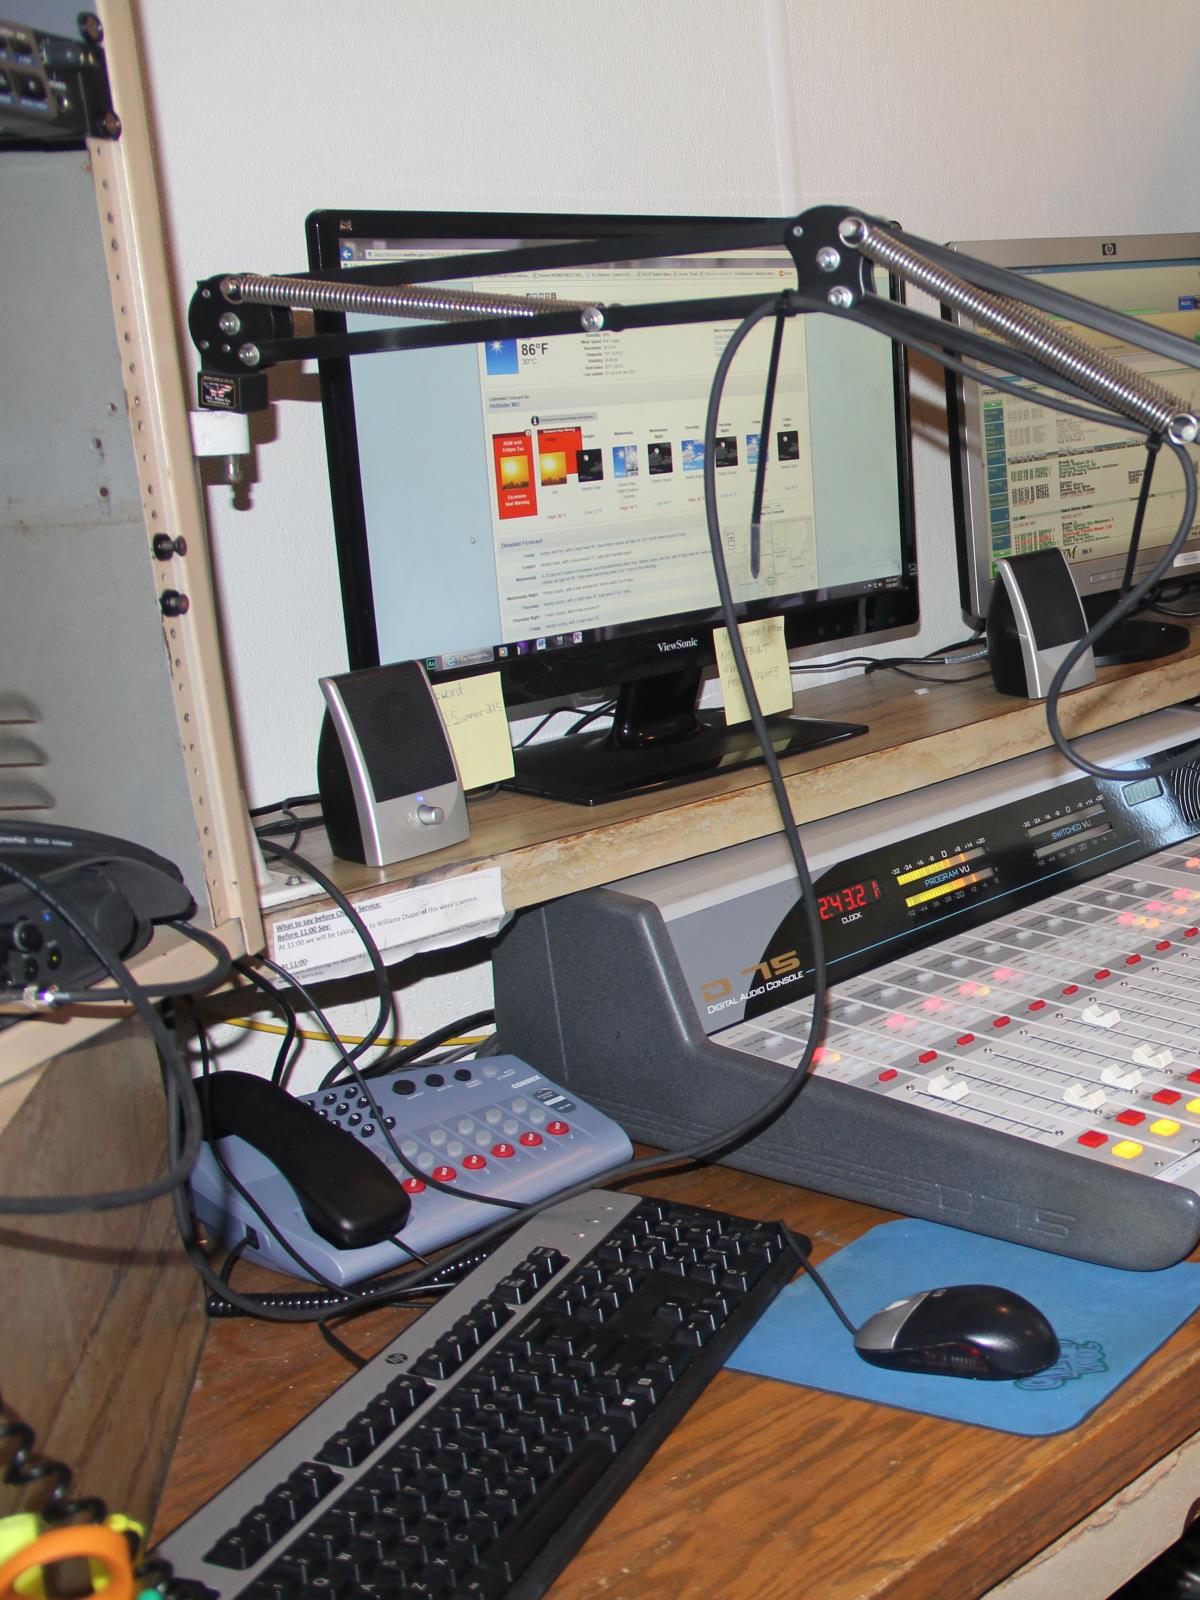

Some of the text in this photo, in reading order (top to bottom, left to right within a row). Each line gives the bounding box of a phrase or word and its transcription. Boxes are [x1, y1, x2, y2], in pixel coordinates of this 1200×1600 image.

[521, 343, 549, 356] 86°F
[515, 499, 530, 508] Warning
[658, 637, 698, 653] ViewSonic
[1051, 820, 1092, 840] SWITCHED VU
[924, 864, 970, 888] PROGRAM VU
[276, 922, 294, 931] What
[303, 918, 314, 928] say
[314, 912, 334, 922] before
[287, 940, 304, 949] 11:00
[316, 933, 326, 941] will
[336, 928, 355, 938] taking
[378, 916, 401, 926] Williams
[402, 911, 420, 920] Chapel
[428, 905, 438, 913] this
[439, 900, 458, 910] week's
[842, 912, 862, 924] CLOCK
[278, 933, 298, 942] Before
[300, 927, 316, 937] 11:00
[707, 971, 804, 1014] DIGITAL AUDIO CONSOLE
[511, 1074, 542, 1089] COMREX
